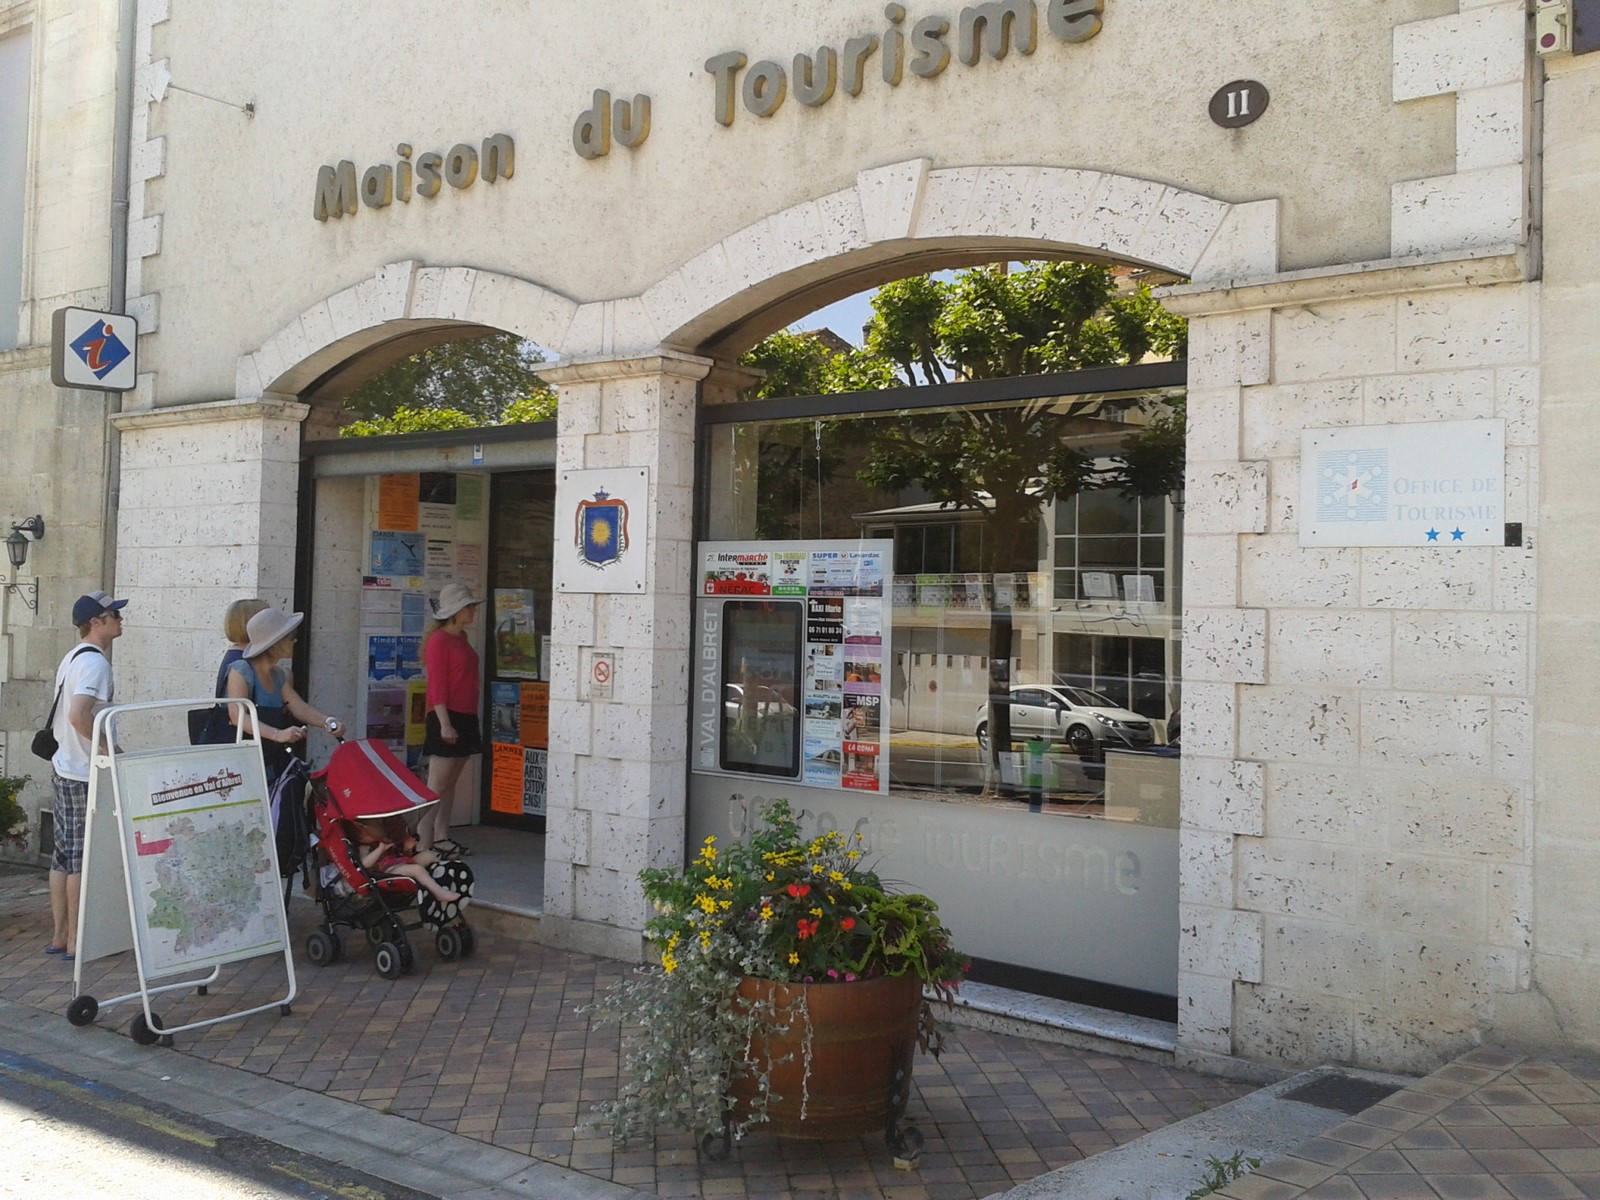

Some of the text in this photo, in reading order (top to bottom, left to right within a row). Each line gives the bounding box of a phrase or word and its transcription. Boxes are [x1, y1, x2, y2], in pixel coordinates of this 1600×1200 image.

[313, 0, 1103, 221] Maison du Tourisme
[1227, 89, 1249, 118] 11
[1471, 477, 1497, 493] DE
[700, 609, 718, 747] VAL D'ALBRET
[856, 696, 880, 706] MSP
[494, 743, 523, 756] LANNES
[525, 749, 540, 764] AUX
[525, 764, 543, 780] ARTS
[152, 786, 194, 803] Bienvenue
[194, 783, 204, 792] en
[203, 780, 215, 791] Val
[524, 793, 541, 809] ENS!
